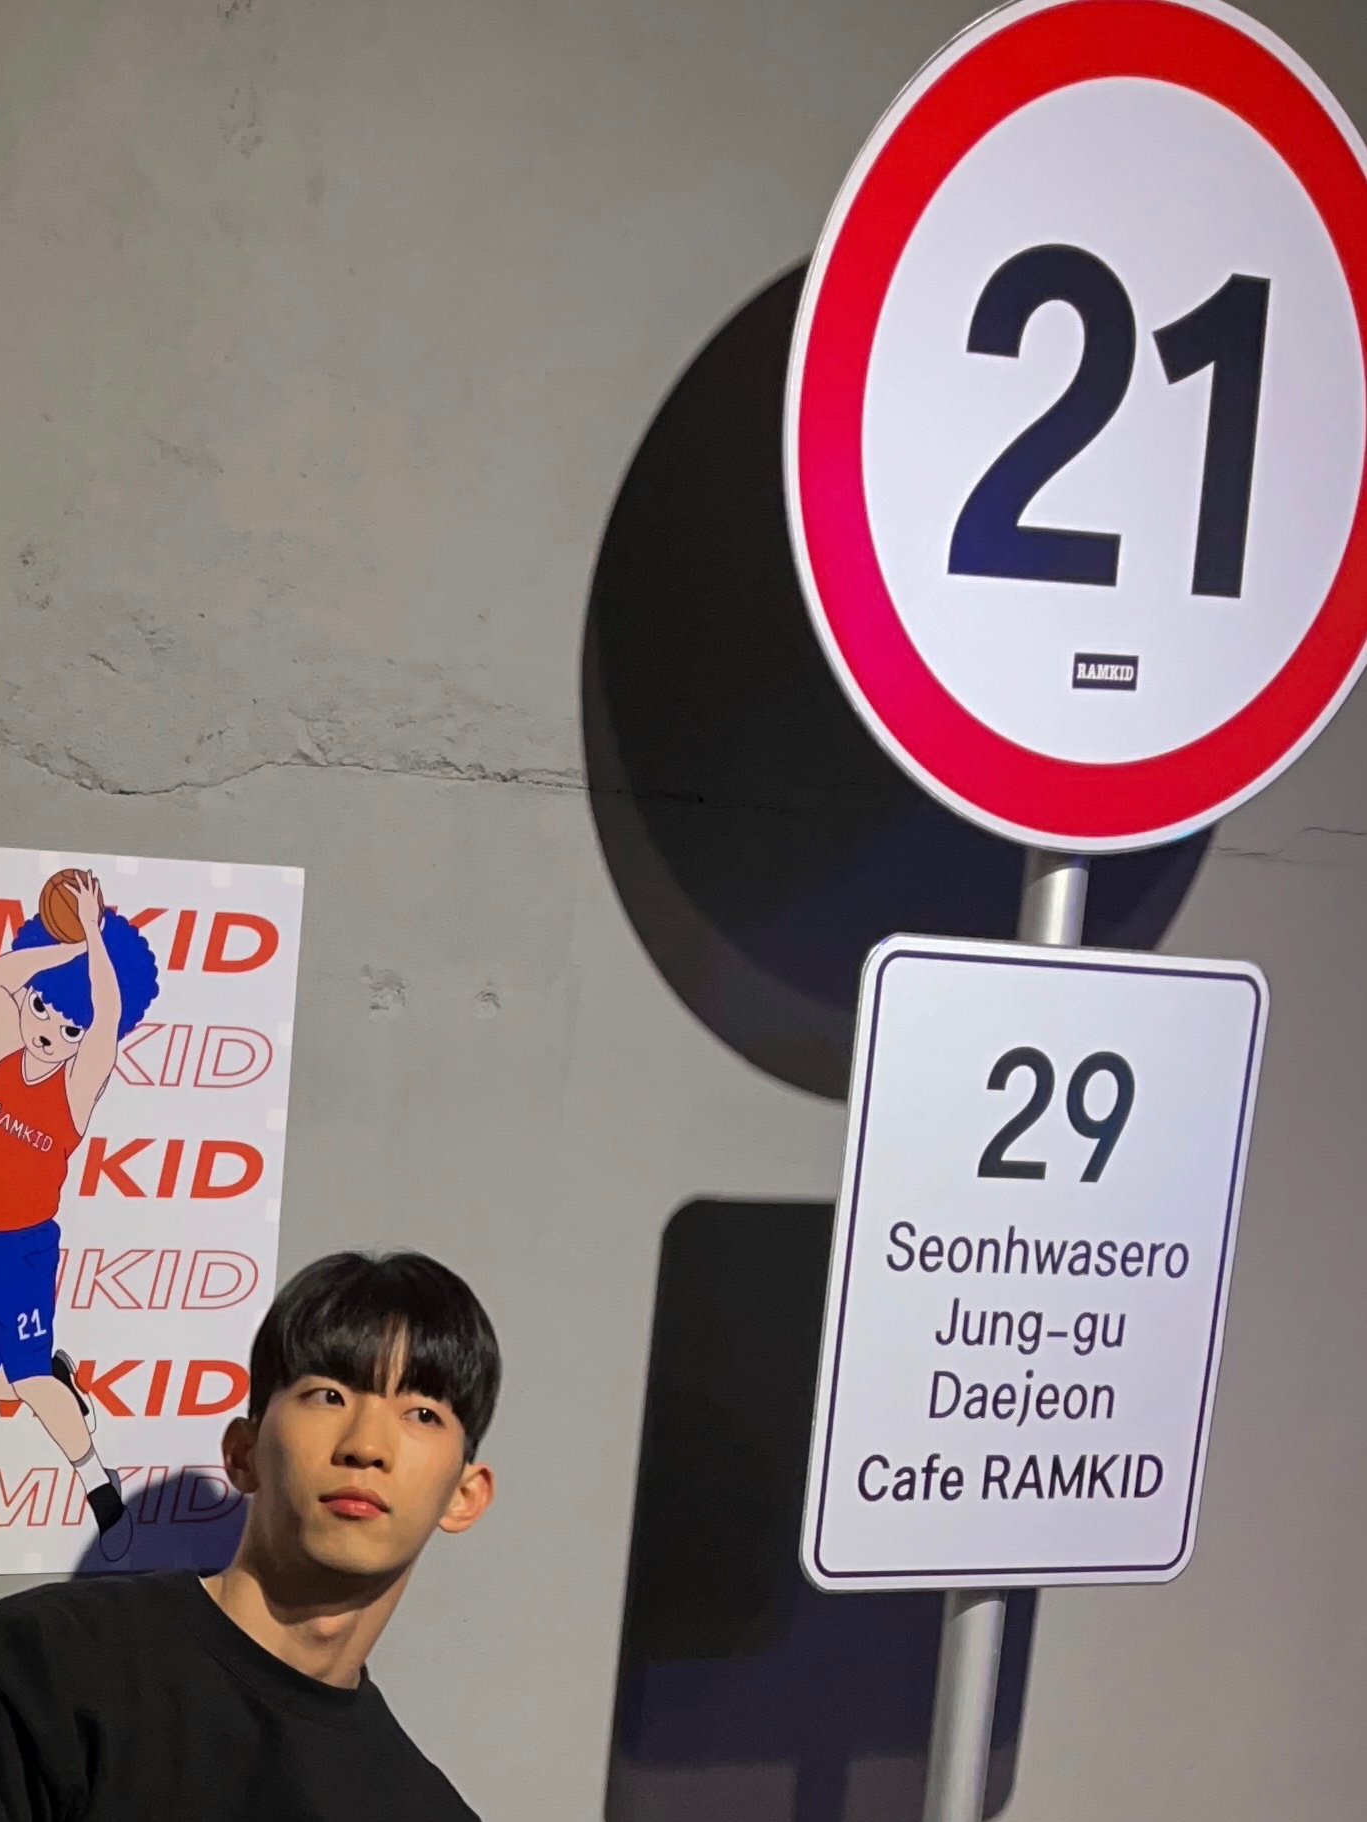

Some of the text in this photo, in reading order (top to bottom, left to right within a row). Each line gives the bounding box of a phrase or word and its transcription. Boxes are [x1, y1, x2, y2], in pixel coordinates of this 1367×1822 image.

[947, 243, 1271, 599] 21
[1076, 662, 1135, 682] RAMKID
[976, 1045, 1137, 1184] 29
[885, 1220, 1190, 1279] Seonhwasero
[17, 1307, 47, 1341] 21
[934, 1297, 1127, 1356] Jung-gu
[927, 1369, 1115, 1428] Daejeon
[856, 1453, 1165, 1502] Cafe RAMKID
